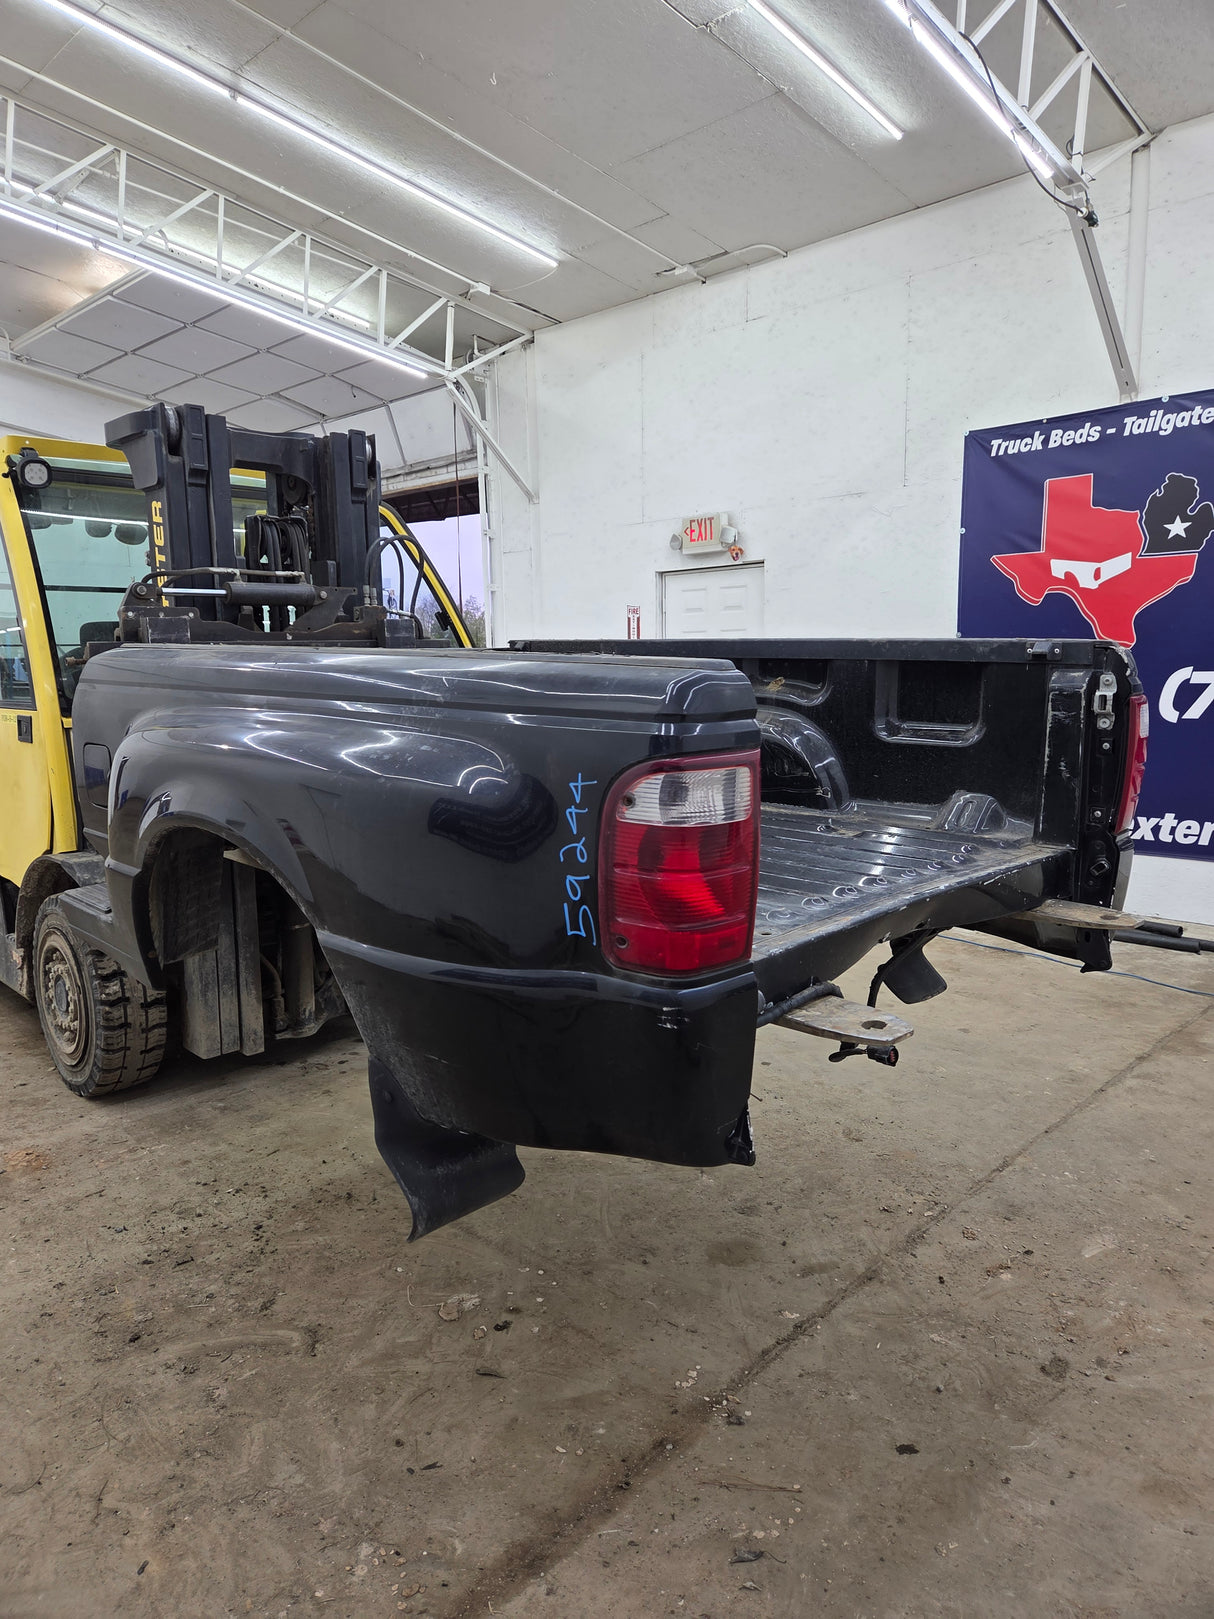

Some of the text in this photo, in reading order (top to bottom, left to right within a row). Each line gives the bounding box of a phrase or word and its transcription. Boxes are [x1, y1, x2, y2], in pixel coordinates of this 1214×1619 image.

[990, 431, 1046, 457] Truck
[1048, 422, 1101, 449] Beds
[689, 516, 715, 543] EXIT
[559, 772, 598, 946] 59244
